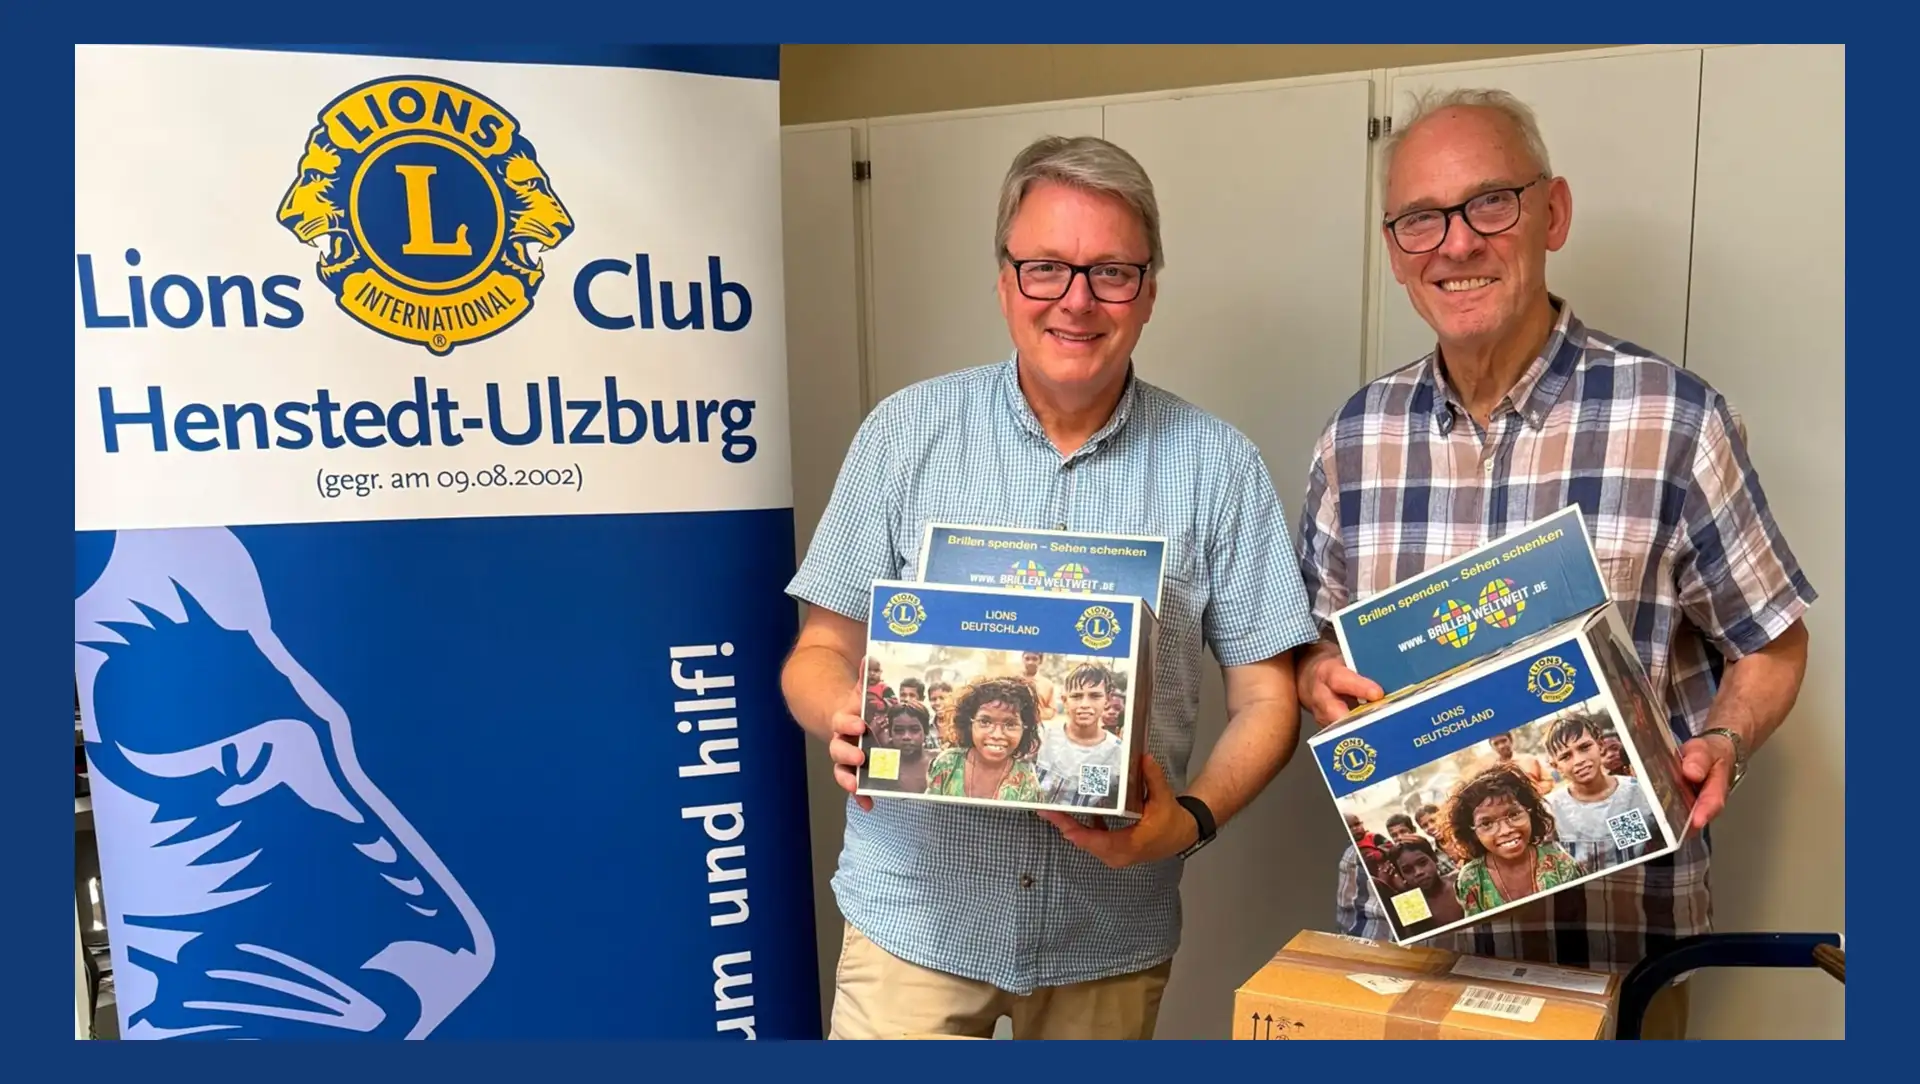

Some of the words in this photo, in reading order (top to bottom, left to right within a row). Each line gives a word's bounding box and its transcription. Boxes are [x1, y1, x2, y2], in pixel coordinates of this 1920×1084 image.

[335, 86, 504, 149] LIONS
[395, 165, 472, 256] L
[76, 248, 304, 330] Lions
[573, 253, 752, 332] Club
[353, 282, 517, 331] INTERNATIONAL
[98, 376, 758, 463] Henstedt-Ulzburg
[315, 467, 383, 498] (gegr.
[391, 469, 429, 489] am
[437, 463, 583, 492] 09.08.2002)
[948, 535, 985, 548] Brillen
[988, 539, 1038, 551] spenden
[1050, 542, 1087, 554] Sehen
[1090, 545, 1147, 557] schenken
[1358, 603, 1396, 626] Brillen
[1398, 578, 1450, 610] spenden
[1460, 556, 1500, 581] Sehen
[1501, 527, 1565, 561] schenken
[892, 593, 919, 604] LIONS
[899, 605, 911, 621] L
[985, 610, 1017, 622] LIONS
[1086, 606, 1113, 619] LIONS
[1427, 613, 1472, 640] BRILLEN
[1471, 586, 1530, 620] WELTWEIT
[961, 620, 1040, 636] DEUTSCHLAND
[1092, 619, 1105, 635] L
[1531, 657, 1560, 673] LIONS
[1543, 671, 1562, 688] L
[669, 641, 741, 778] hilf!
[1431, 704, 1465, 727] LIONS
[1413, 708, 1495, 748] DEUTSCHLAND
[1336, 738, 1361, 753] LIONS
[1347, 751, 1364, 768] L
[681, 802, 750, 927] und
